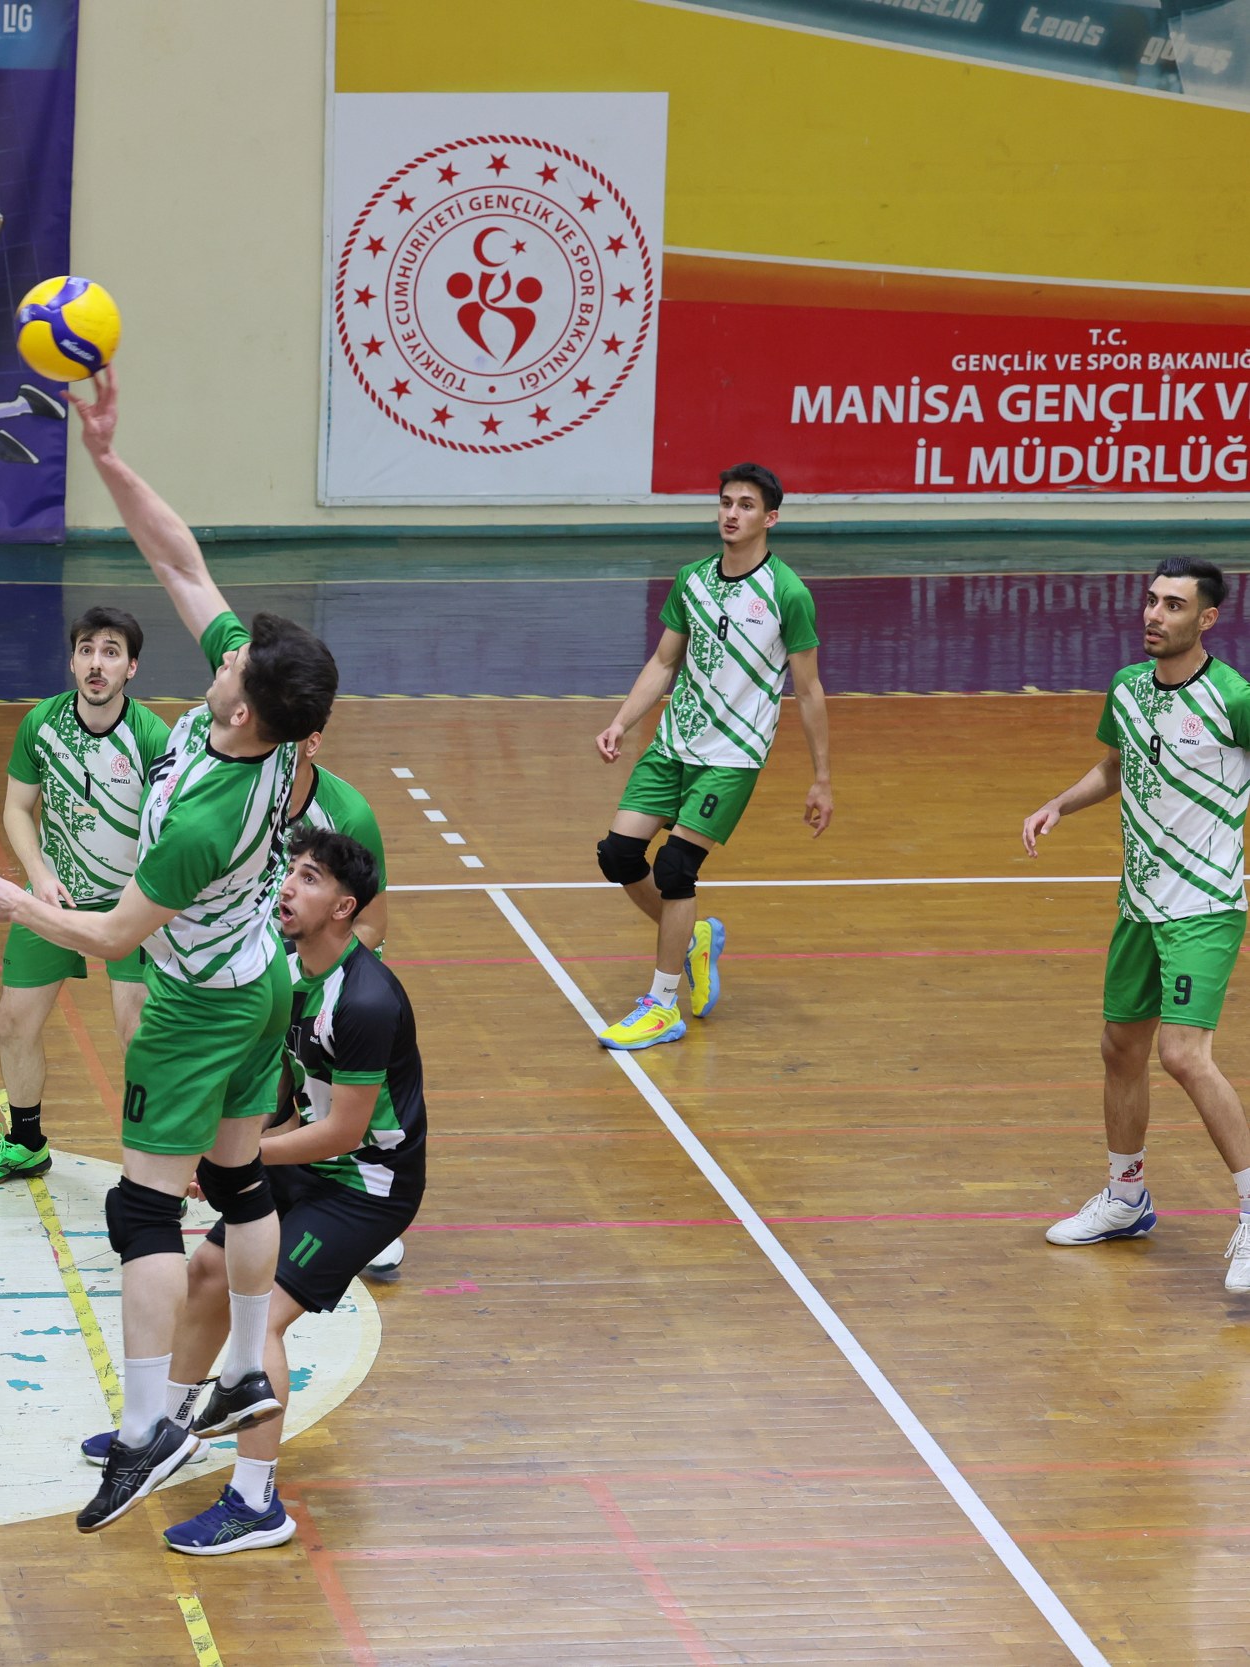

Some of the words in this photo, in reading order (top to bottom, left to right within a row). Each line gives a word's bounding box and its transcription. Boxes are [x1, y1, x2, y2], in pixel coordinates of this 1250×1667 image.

[1020, 6, 1105, 46] tenis
[469, 194, 554, 225] GENÇLİK
[553, 218, 577, 244] VE
[394, 199, 465, 325] CUMHURİYETİ
[570, 245, 595, 297] SPOR
[519, 303, 594, 391] BAKANLIĞI
[1089, 328, 1128, 345] T.C.
[402, 328, 466, 393] TÜRKİYE
[951, 351, 1048, 376] GENÇLİK
[1054, 354, 1082, 371] VE
[1087, 353, 1142, 371] SPOR
[790, 376, 985, 425] MANİSA
[998, 374, 1206, 433] GENÇLİK
[1214, 382, 1250, 420] V
[914, 438, 954, 485] İL
[717, 615, 729, 641] 8
[1149, 734, 1161, 765] 9
[84, 771, 91, 801] 1
[699, 793, 719, 819] 8
[1173, 974, 1192, 1006] 9
[123, 1080, 147, 1124] 10
[289, 1230, 323, 1268] 11
[175, 1401, 193, 1420] HEART
